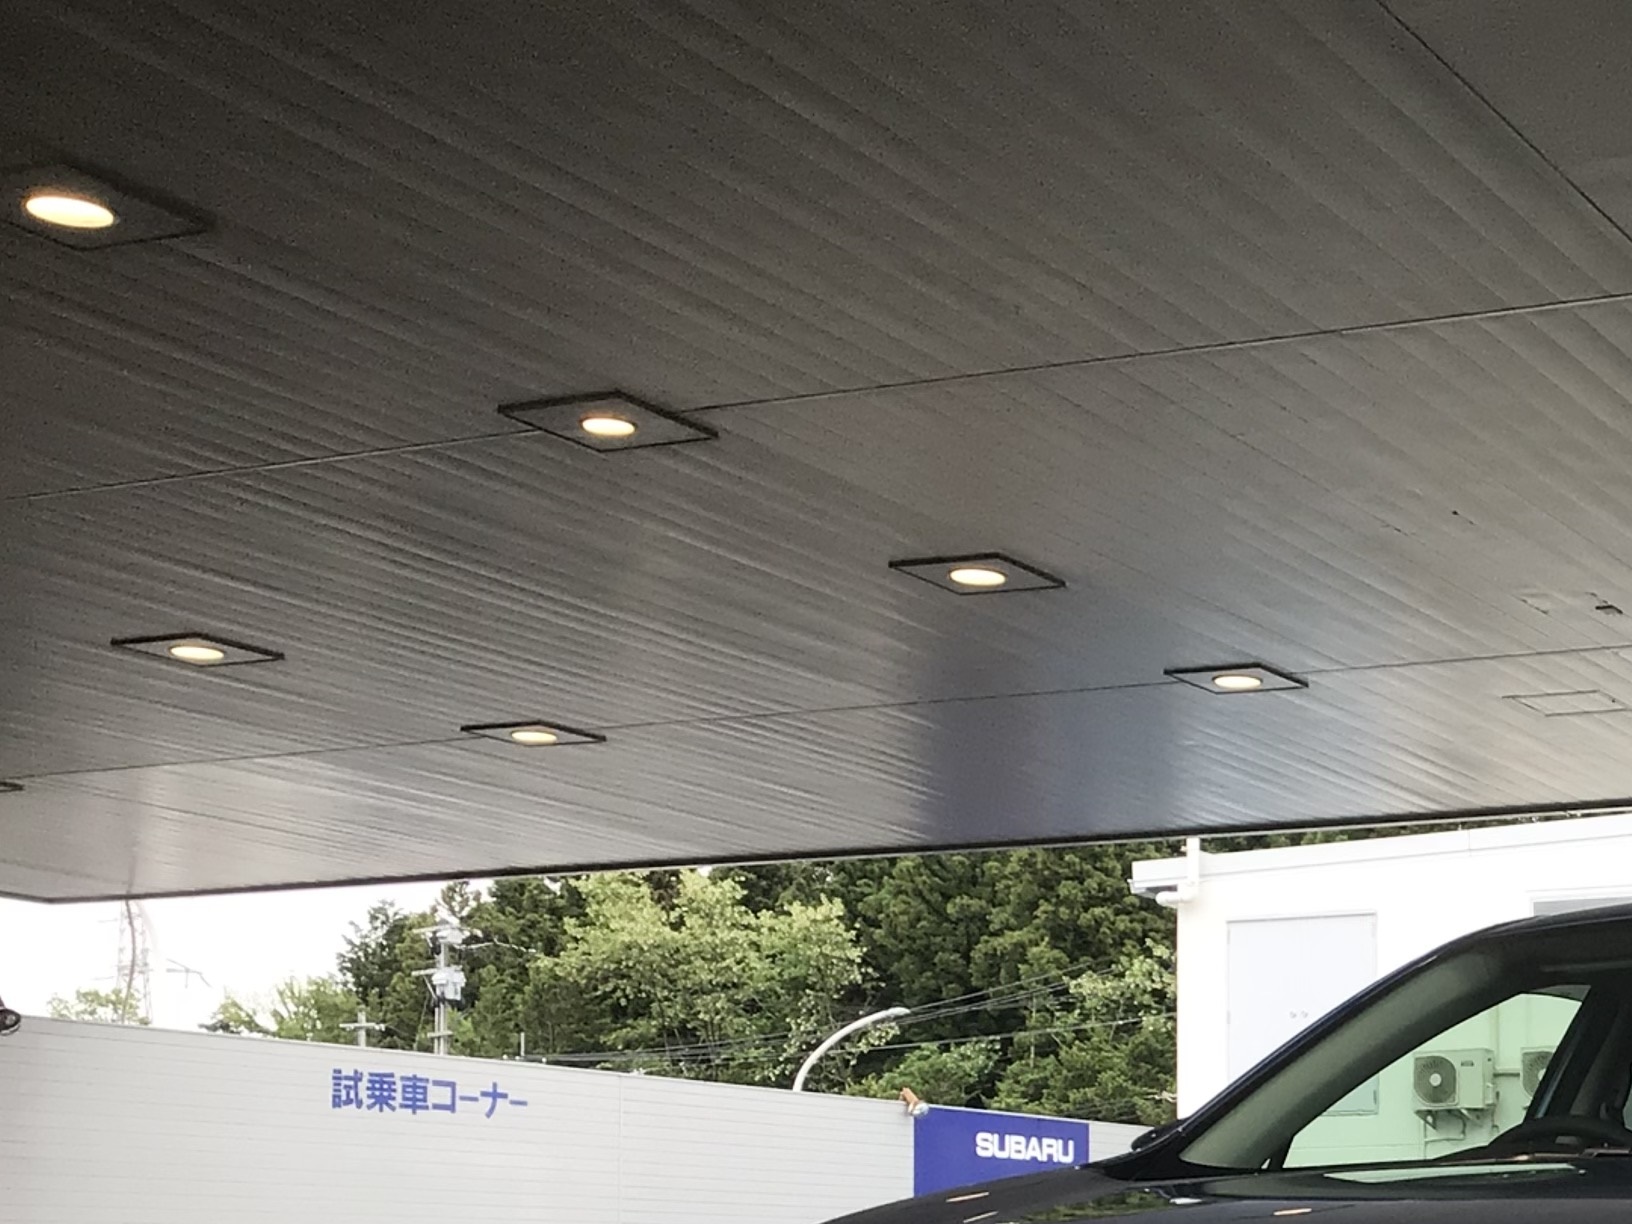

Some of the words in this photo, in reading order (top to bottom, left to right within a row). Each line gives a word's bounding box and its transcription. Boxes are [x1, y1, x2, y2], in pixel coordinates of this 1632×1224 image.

[331, 1068, 528, 1119] 試乗車コーナー
[975, 1131, 1075, 1164] SUBARU
